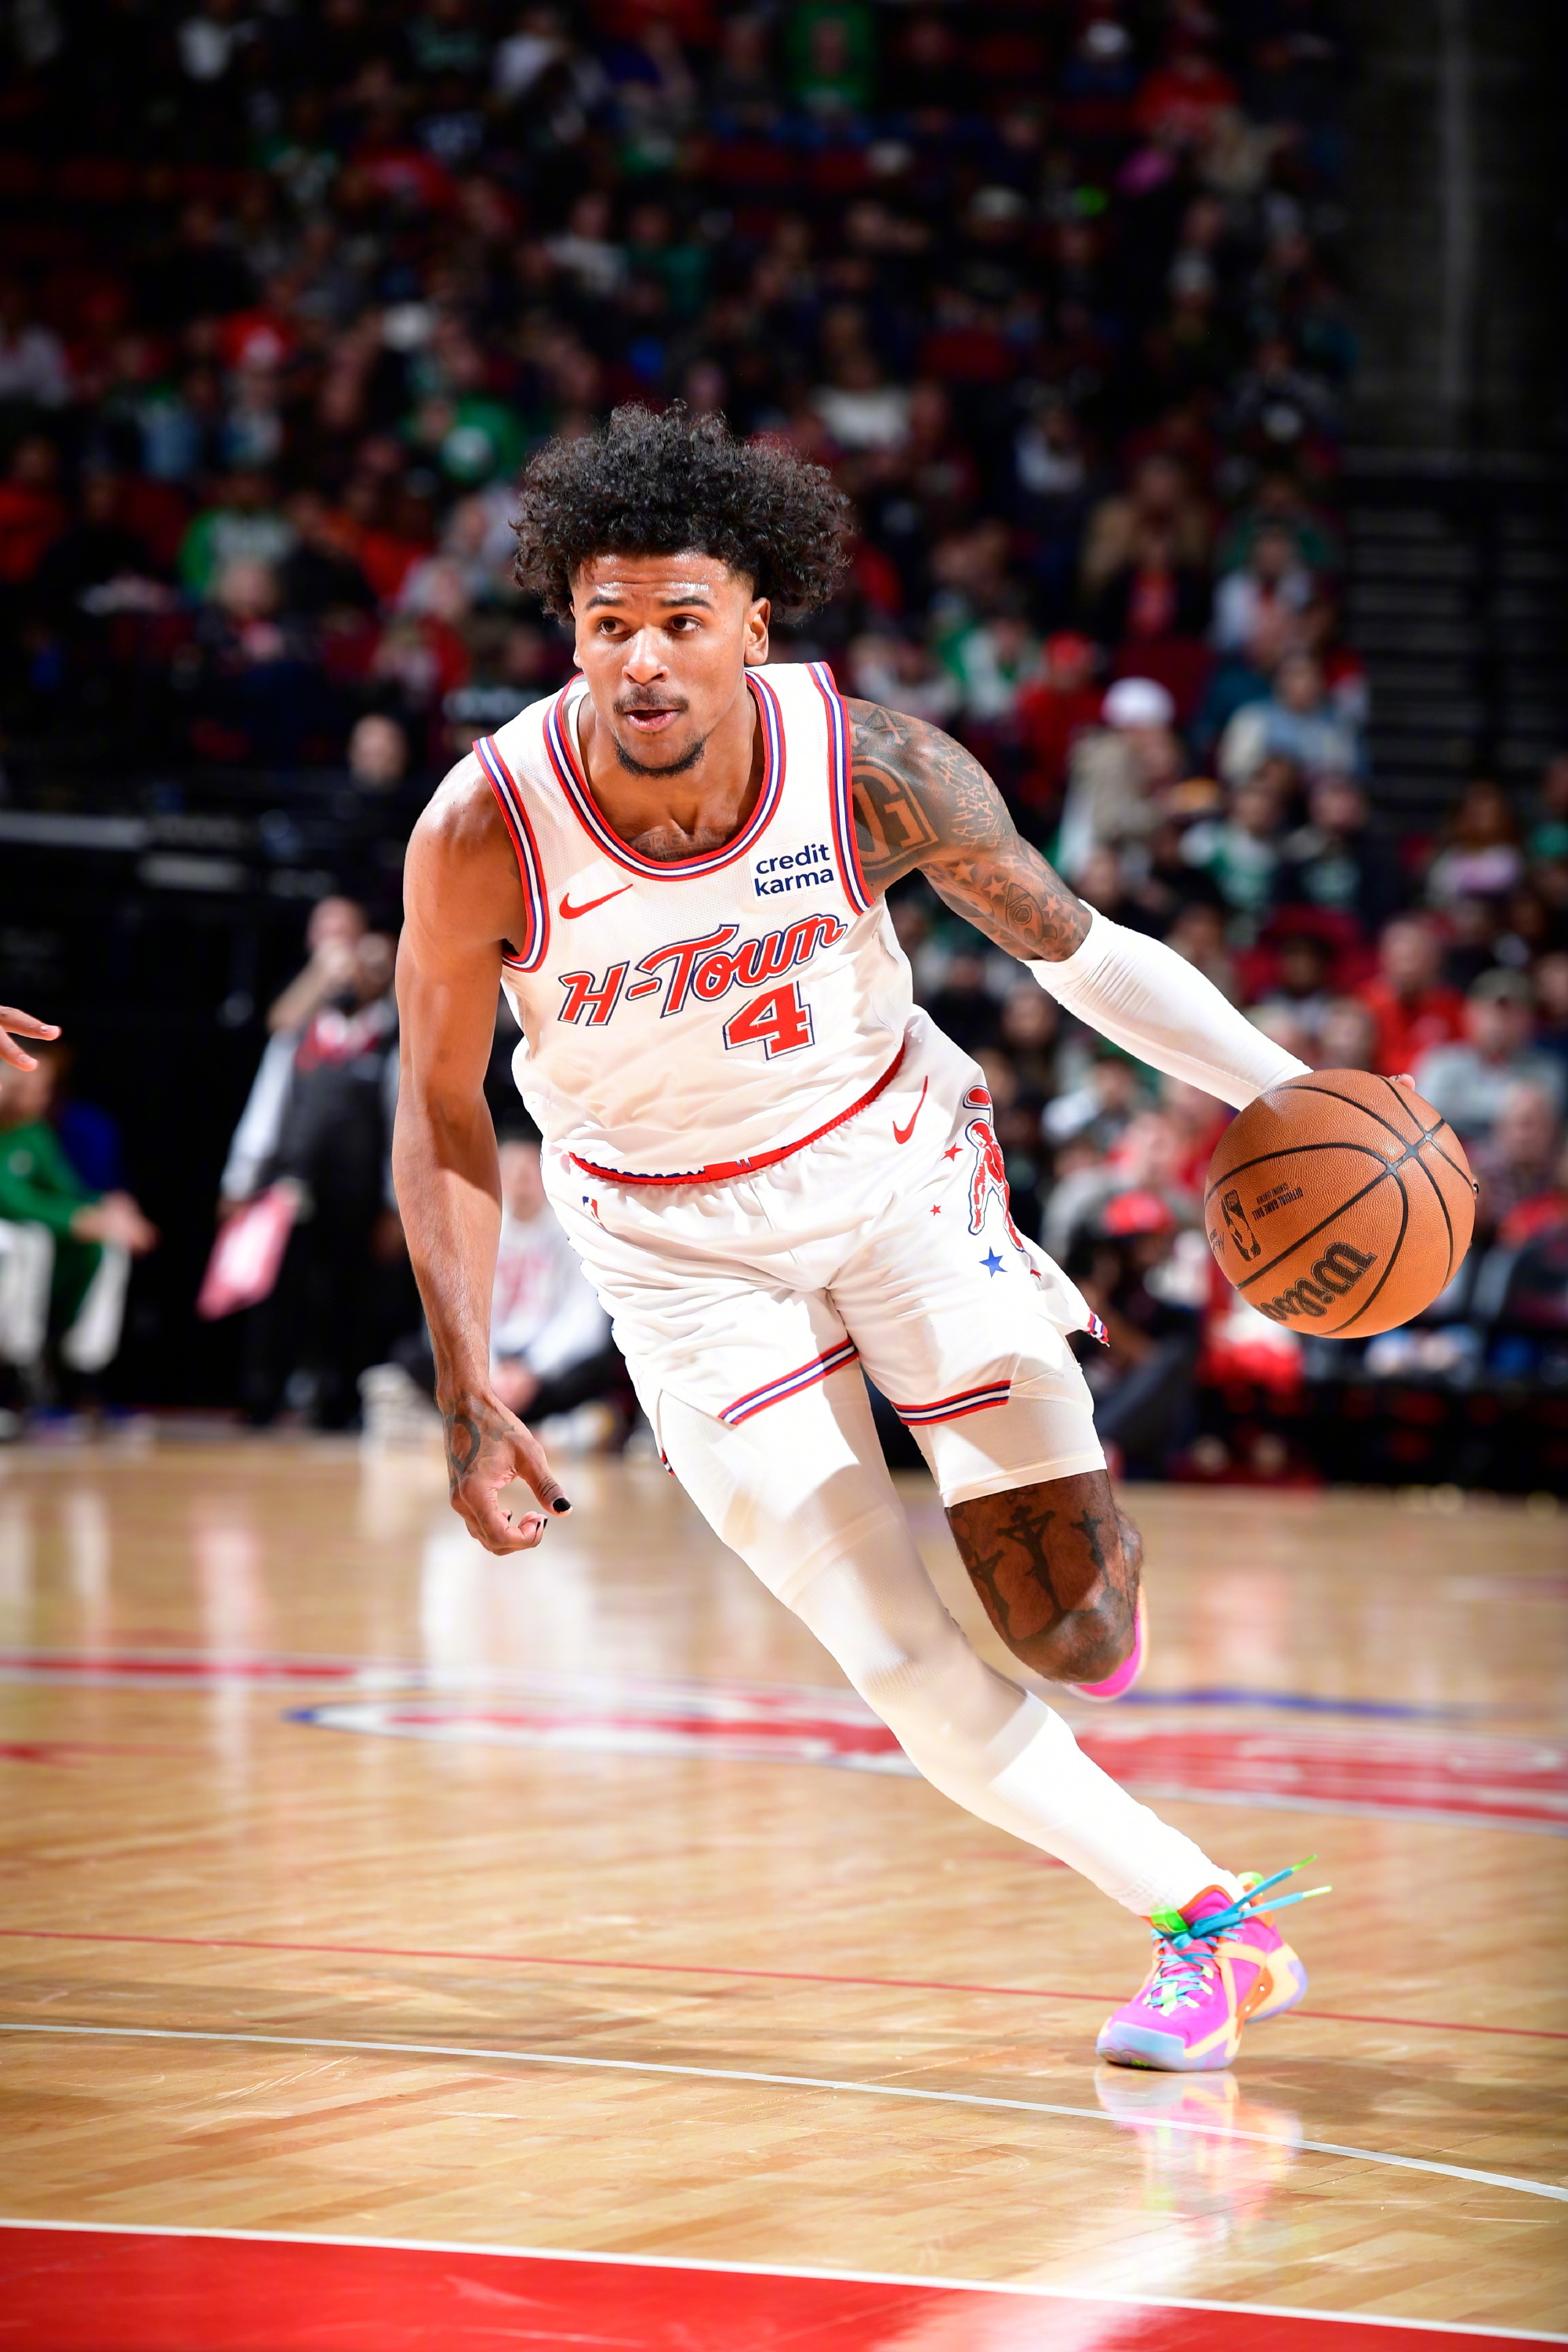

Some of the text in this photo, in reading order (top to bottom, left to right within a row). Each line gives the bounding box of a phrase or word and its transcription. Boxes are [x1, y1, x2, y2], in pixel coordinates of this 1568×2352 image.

[755, 843, 831, 875] credit
[753, 866, 834, 898] karma
[557, 914, 848, 1027] H-Town
[722, 979, 815, 1061] 4
[1262, 1199, 1279, 1215] GAME
[1278, 1187, 1303, 1206] OFFICIAL
[1254, 1242, 1377, 1320] Wilso
